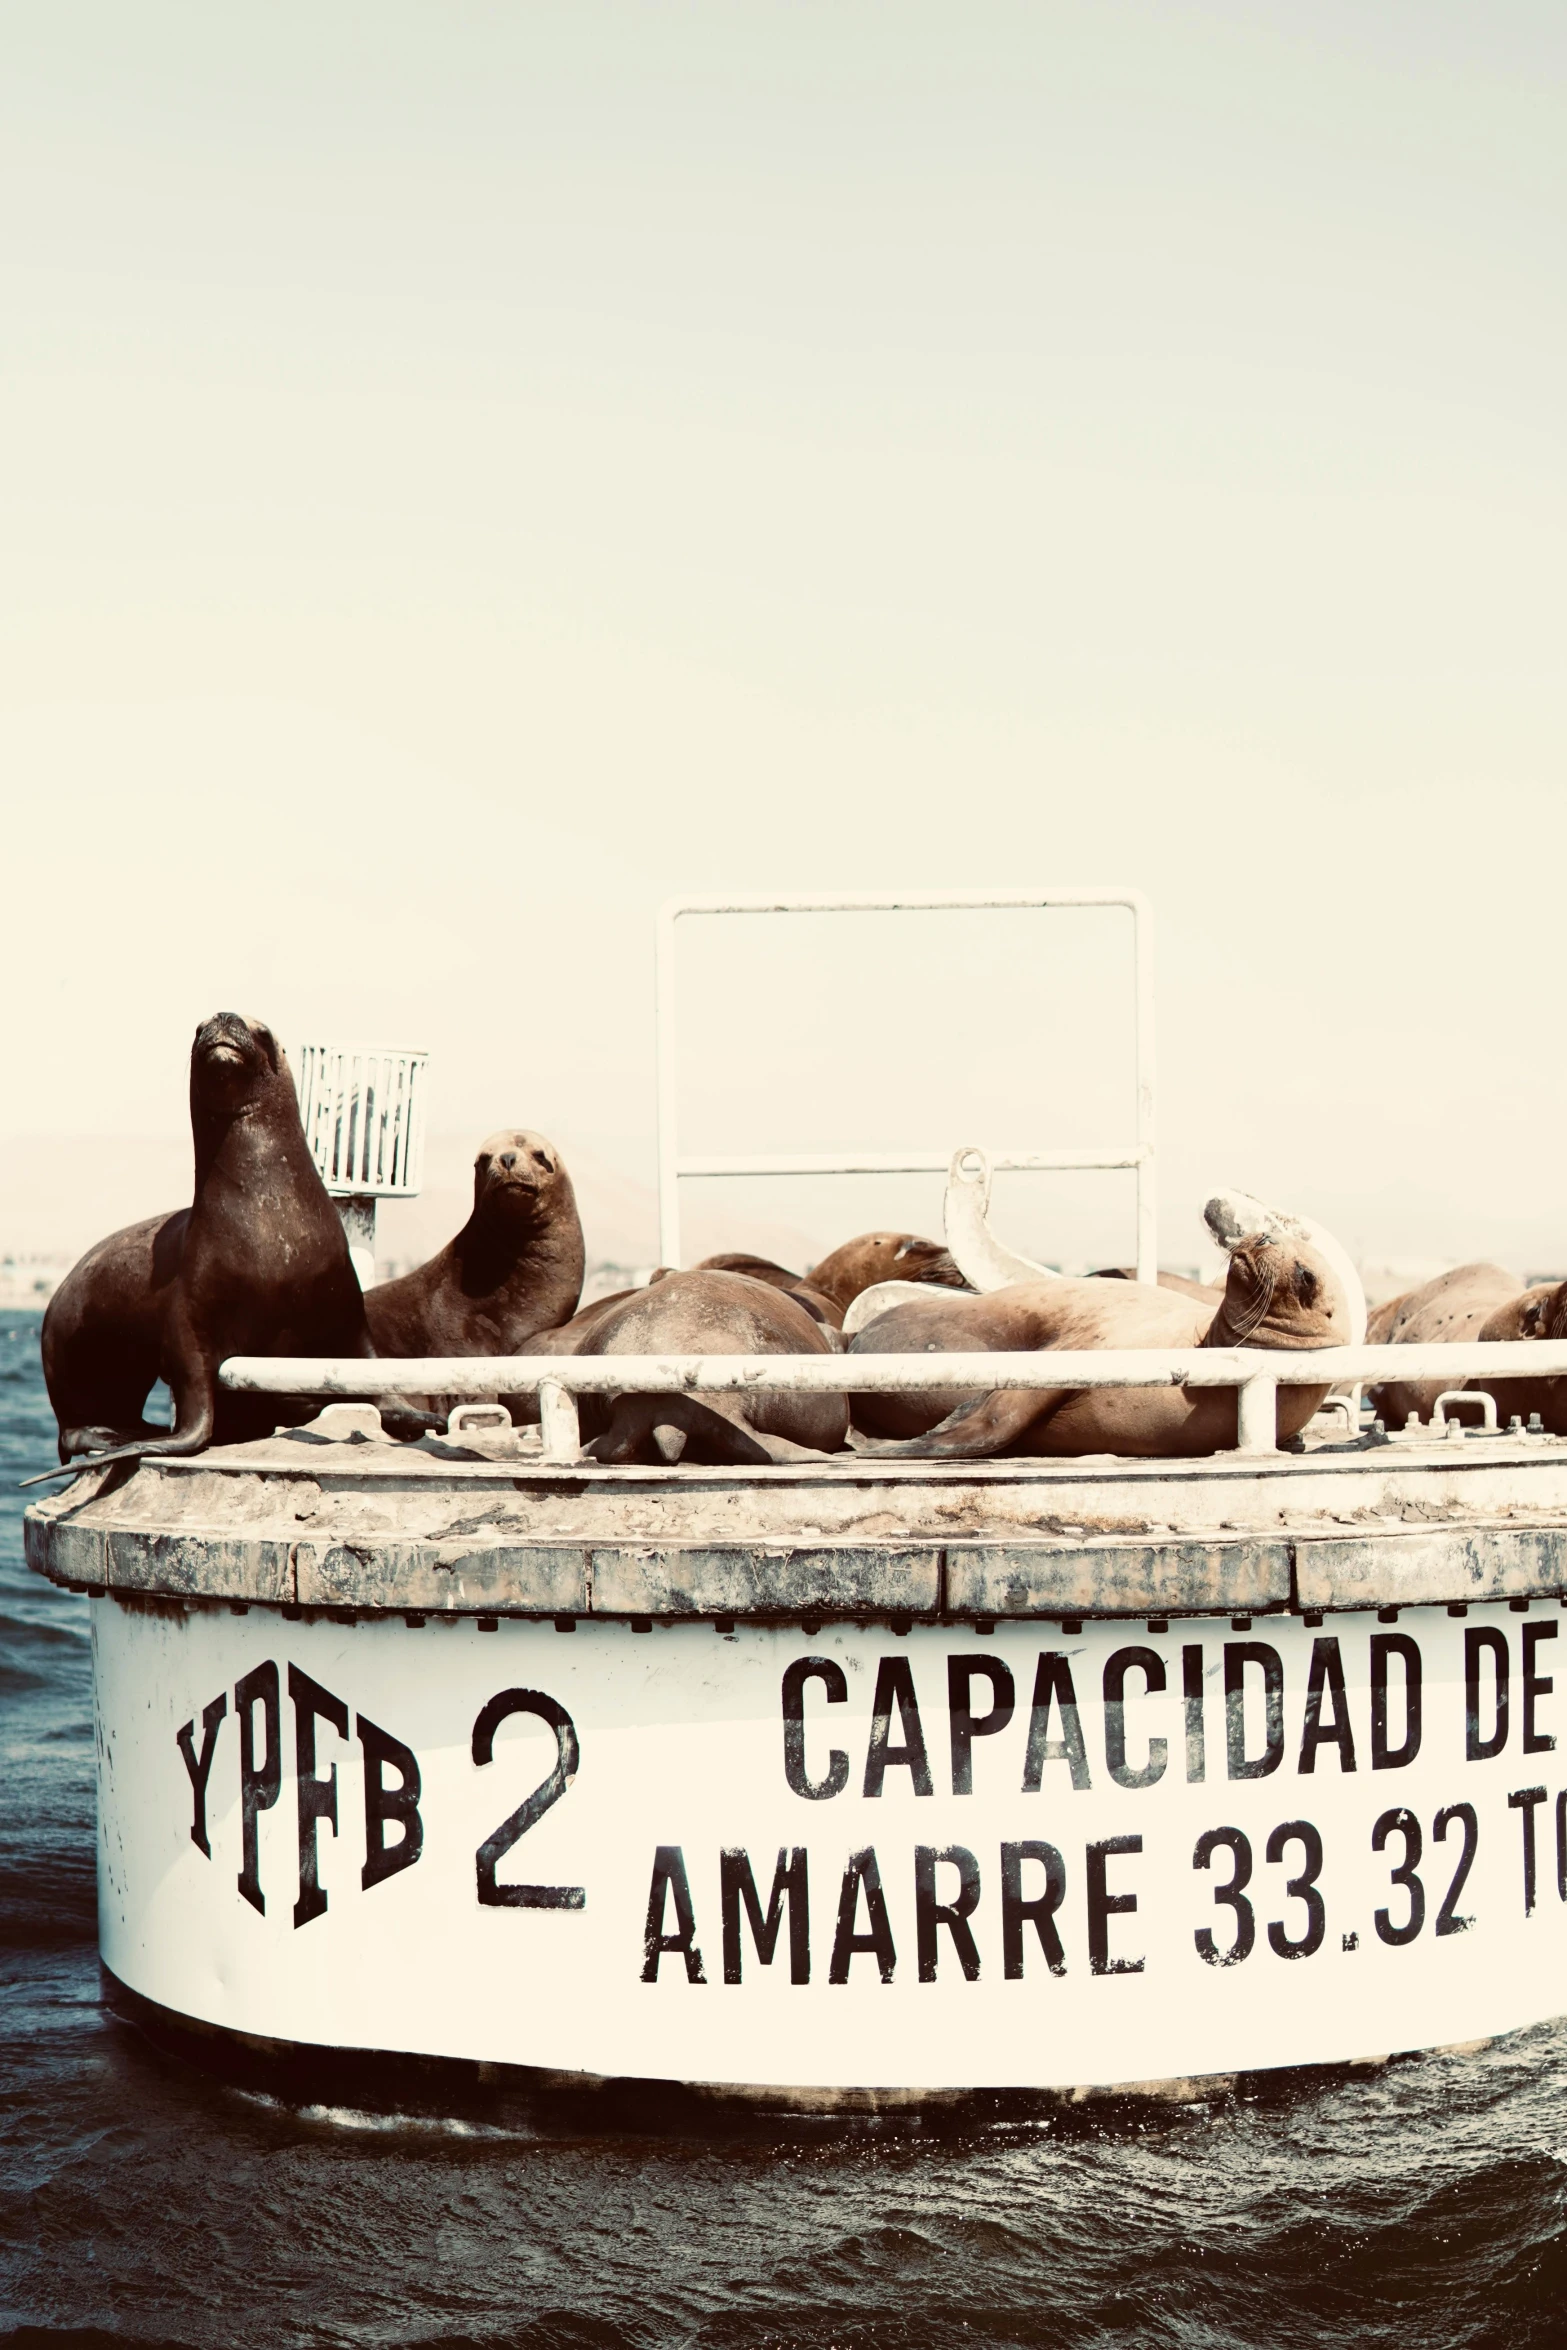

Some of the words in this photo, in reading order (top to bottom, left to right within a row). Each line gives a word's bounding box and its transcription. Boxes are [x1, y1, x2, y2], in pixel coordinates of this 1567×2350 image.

[177, 1659, 424, 1930] YPFB
[471, 1687, 586, 1910] 2
[782, 1633, 1422, 1800] CAPACIDAD
[1464, 1619, 1558, 1761] DE
[640, 1835, 1146, 1985] AMARRE
[1192, 1802, 1478, 1967] 33.32
[1507, 1785, 1567, 1918] T
